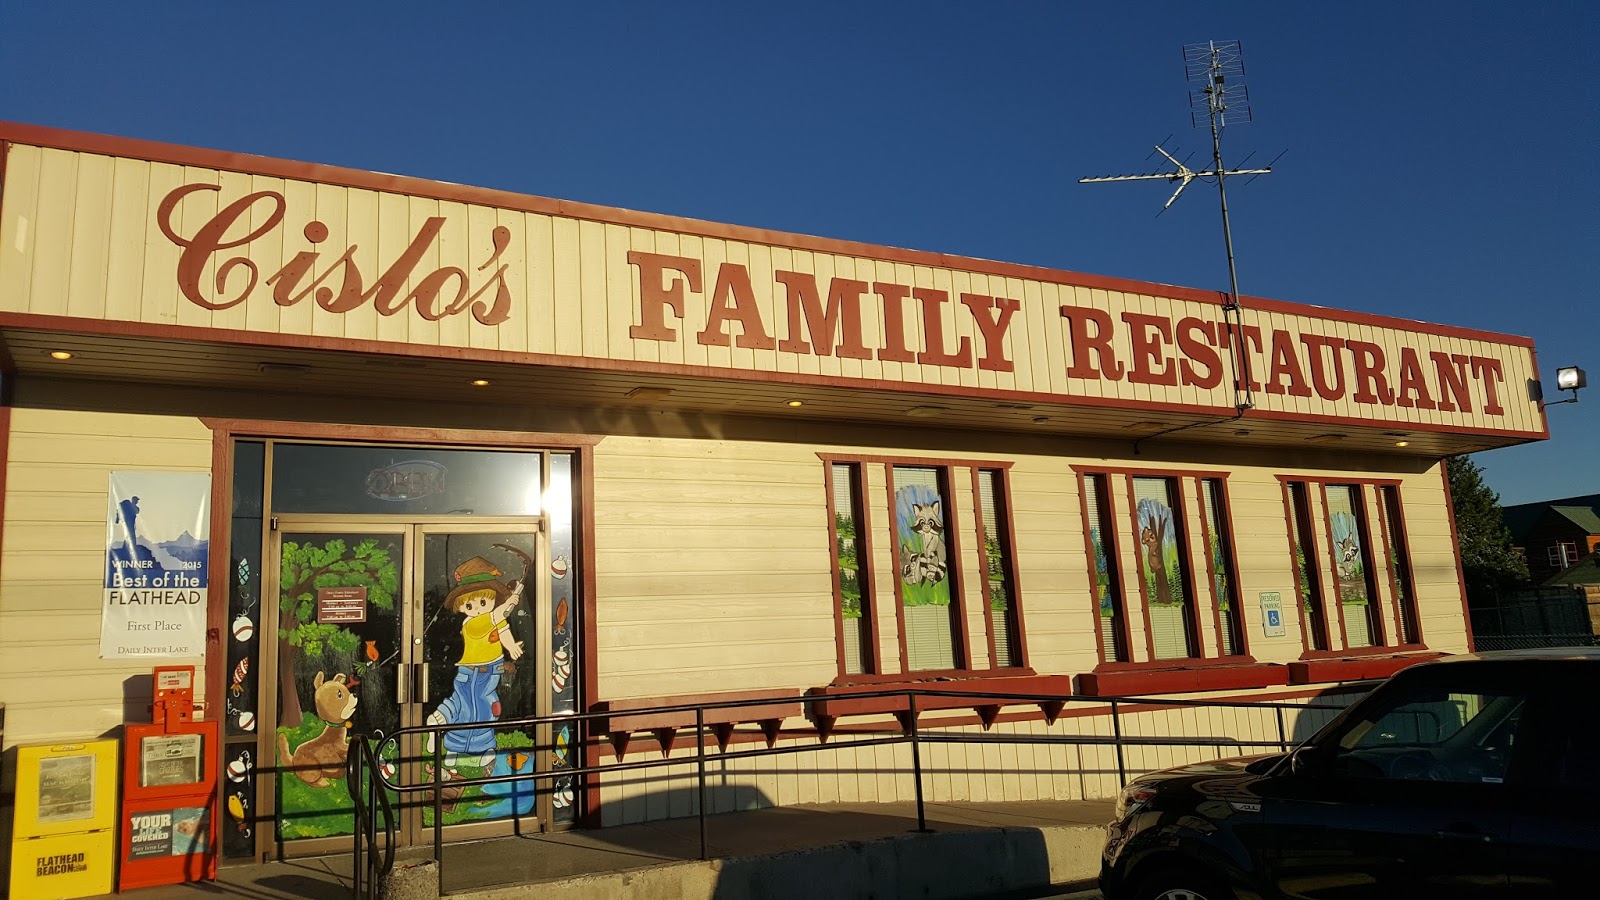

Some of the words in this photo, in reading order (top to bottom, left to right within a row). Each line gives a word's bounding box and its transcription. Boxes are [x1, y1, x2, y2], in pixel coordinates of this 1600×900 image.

[157, 183, 511, 326] Cislo's
[627, 250, 1020, 373] FAMILY
[1061, 305, 1504, 416] RESTAURANT
[366, 468, 446, 496] OPEN
[111, 560, 153, 569] WINNER
[182, 561, 202, 569] 2015
[113, 572, 148, 588] Best
[152, 572, 170, 588] of
[174, 572, 200, 588] the
[109, 591, 201, 605] FLATHEAD
[127, 621, 151, 631] First
[154, 620, 182, 631] Place
[117, 646, 141, 655] DAILY
[143, 645, 167, 654] INTER
[169, 645, 189, 653] LAKE
[130, 814, 172, 831] YOUR
[131, 832, 169, 843] COVERED
[37, 853, 84, 867] FLATHEAD
